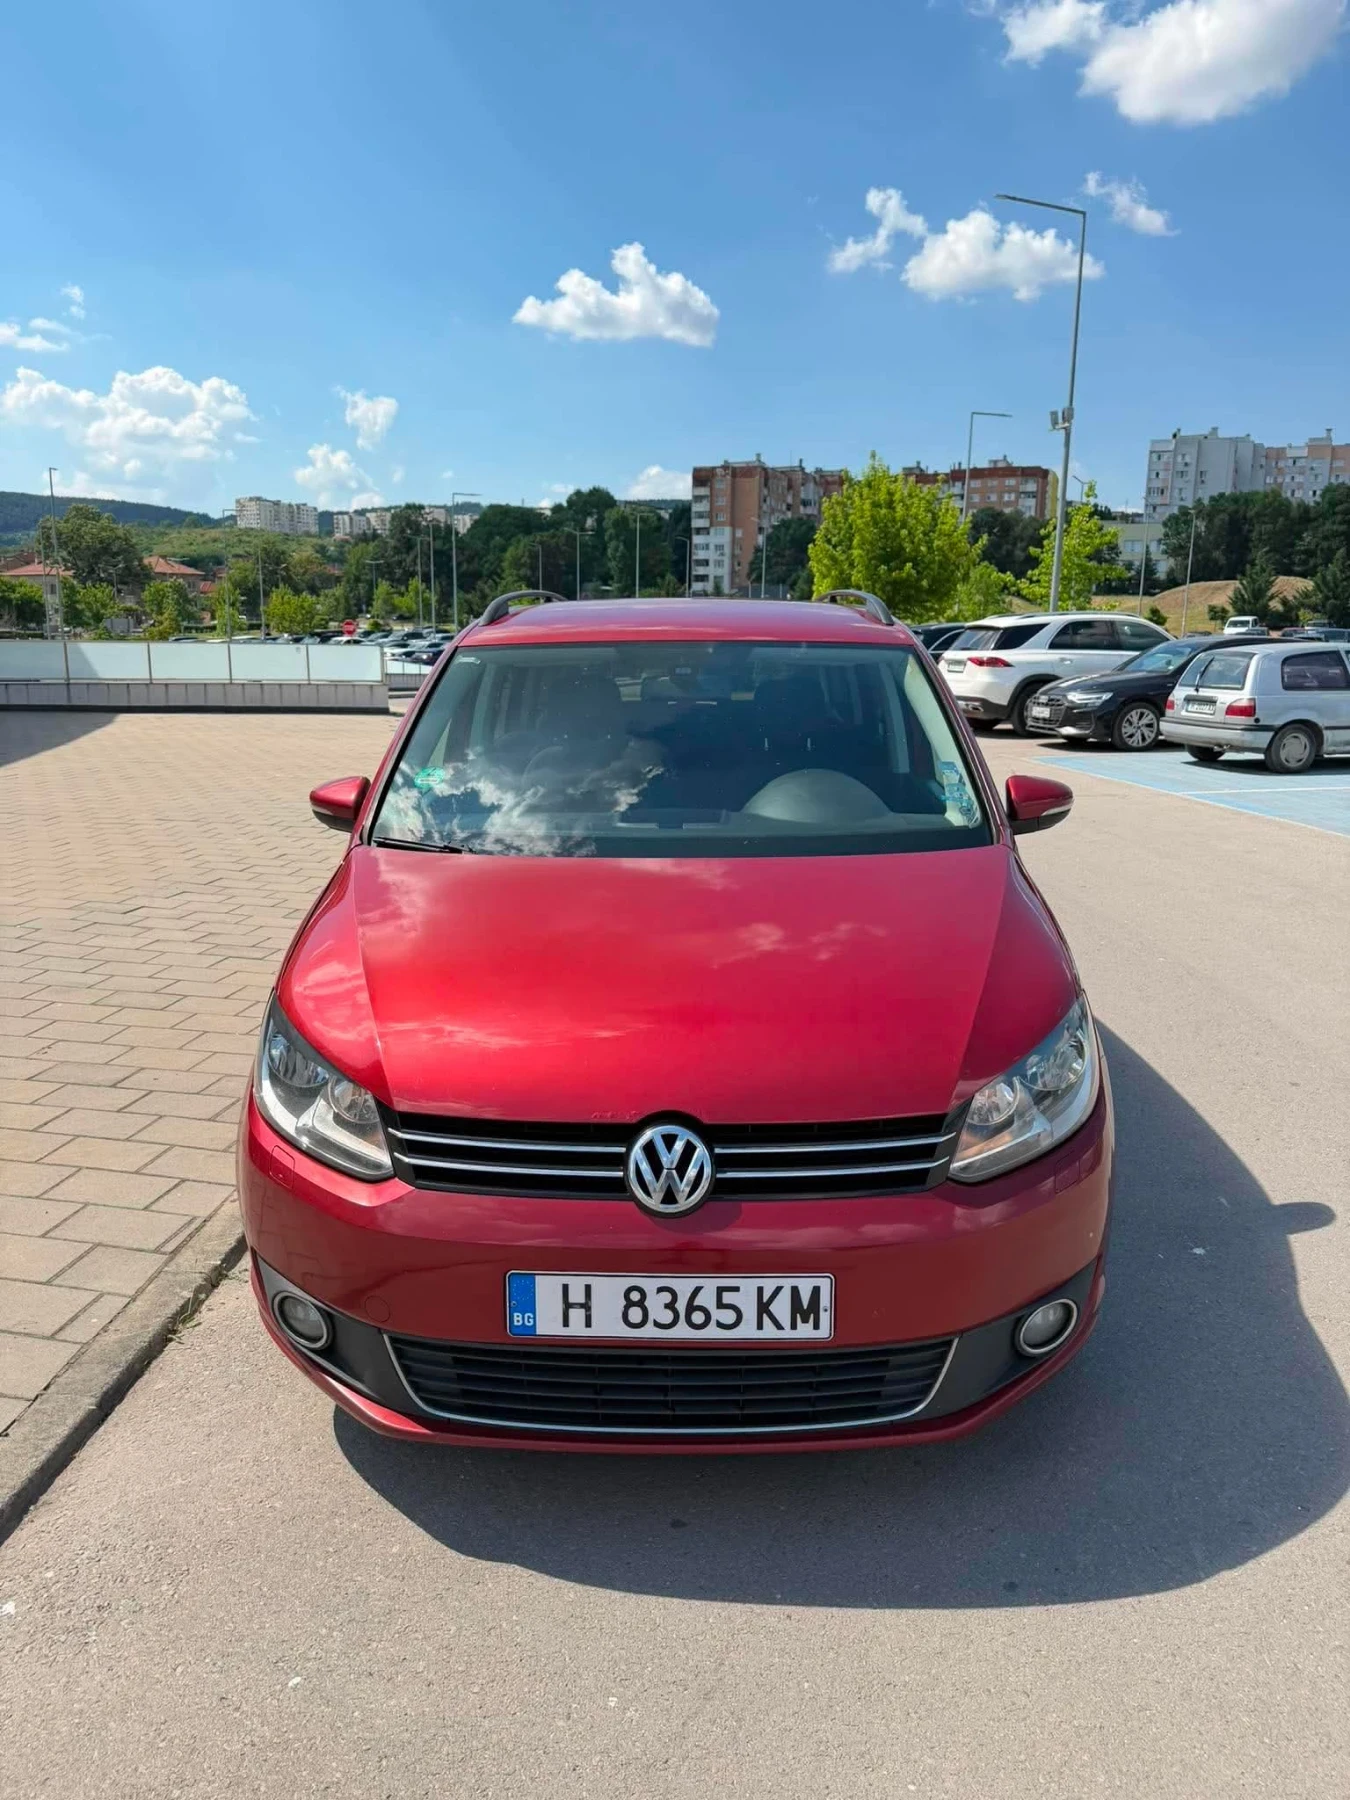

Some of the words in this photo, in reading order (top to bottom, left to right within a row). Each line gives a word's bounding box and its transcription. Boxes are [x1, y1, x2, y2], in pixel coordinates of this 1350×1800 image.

[631, 1127, 710, 1211] VW
[513, 1312, 534, 1326] BG
[562, 1283, 592, 1328] H
[622, 1285, 743, 1330] 8365
[756, 1285, 821, 1331] KM
